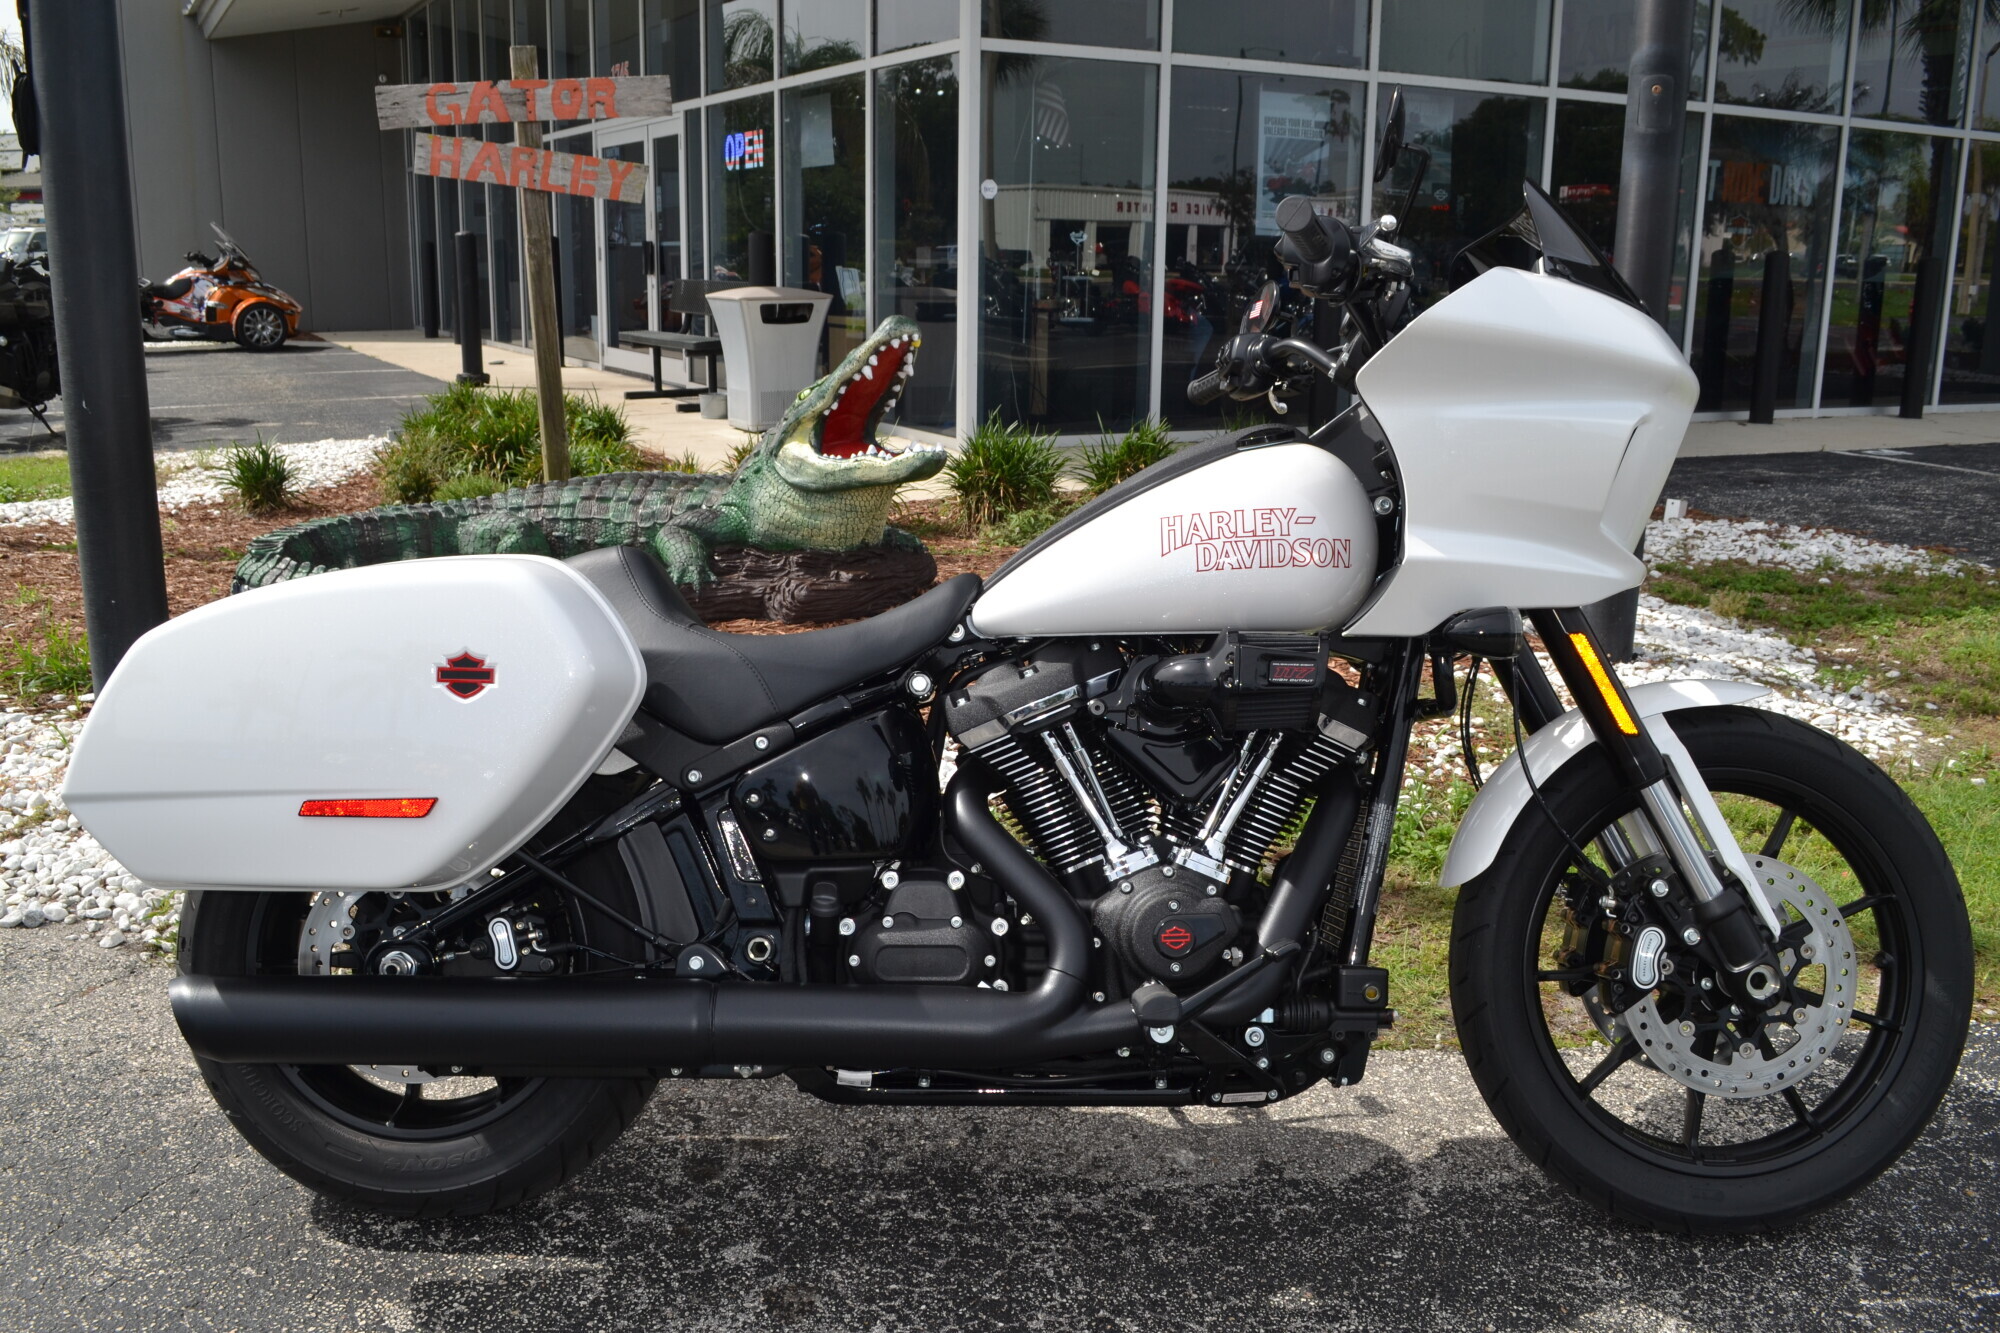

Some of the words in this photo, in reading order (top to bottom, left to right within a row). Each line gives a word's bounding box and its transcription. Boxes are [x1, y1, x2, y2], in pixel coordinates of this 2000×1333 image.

[426, 77, 619, 125] GATOR
[430, 136, 634, 200] HARLEY
[725, 129, 763, 171] OPEN
[1160, 507, 1316, 557] HARLEY-
[1195, 538, 1352, 572] DAVIDSON
[1273, 666, 1316, 678] 117
